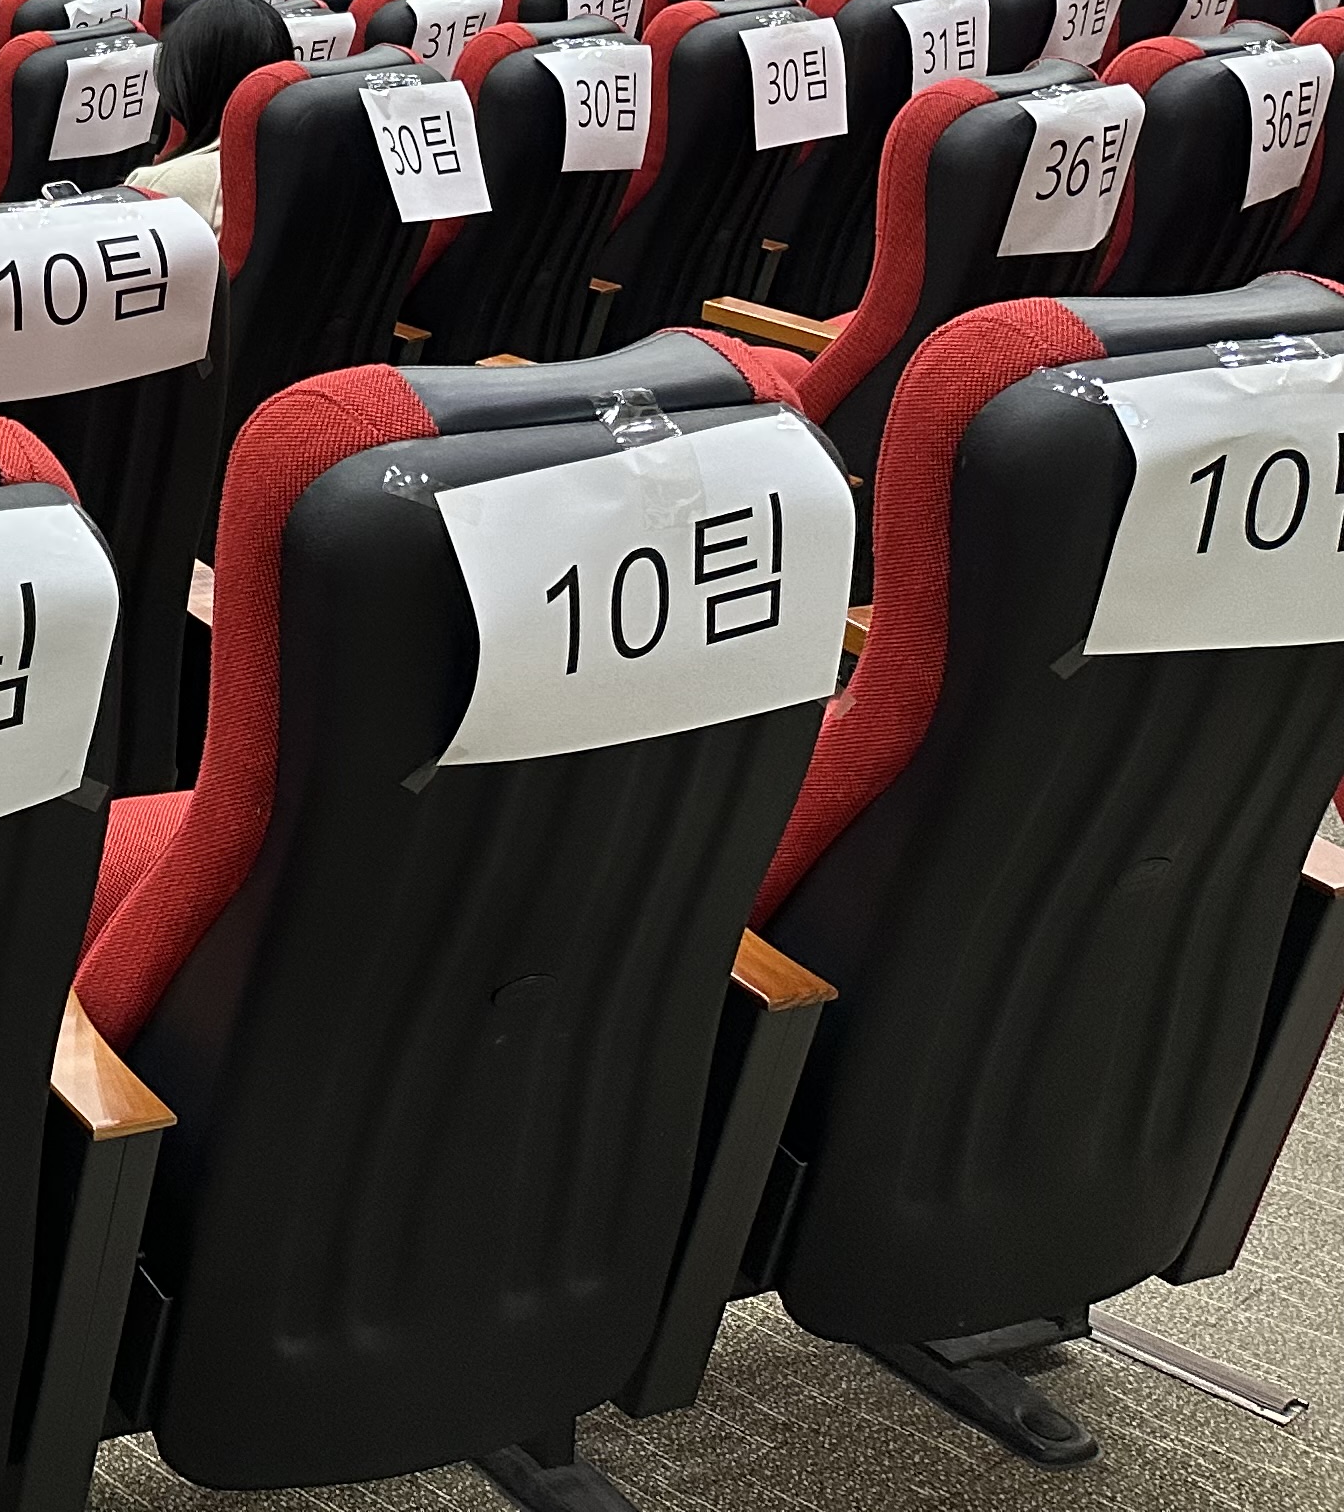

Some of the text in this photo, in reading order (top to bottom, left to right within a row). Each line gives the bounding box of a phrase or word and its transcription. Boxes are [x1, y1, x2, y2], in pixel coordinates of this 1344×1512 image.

[767, 46, 827, 105] 30팀
[922, 16, 976, 75] 31팀
[75, 69, 149, 124] 30팀
[576, 72, 637, 132] 30팀
[1262, 75, 1321, 153] 36팀
[382, 110, 462, 176] 30팀
[1035, 118, 1129, 201] 36팀
[1189, 431, 1343, 555] 10
[546, 491, 783, 676] 10팀
